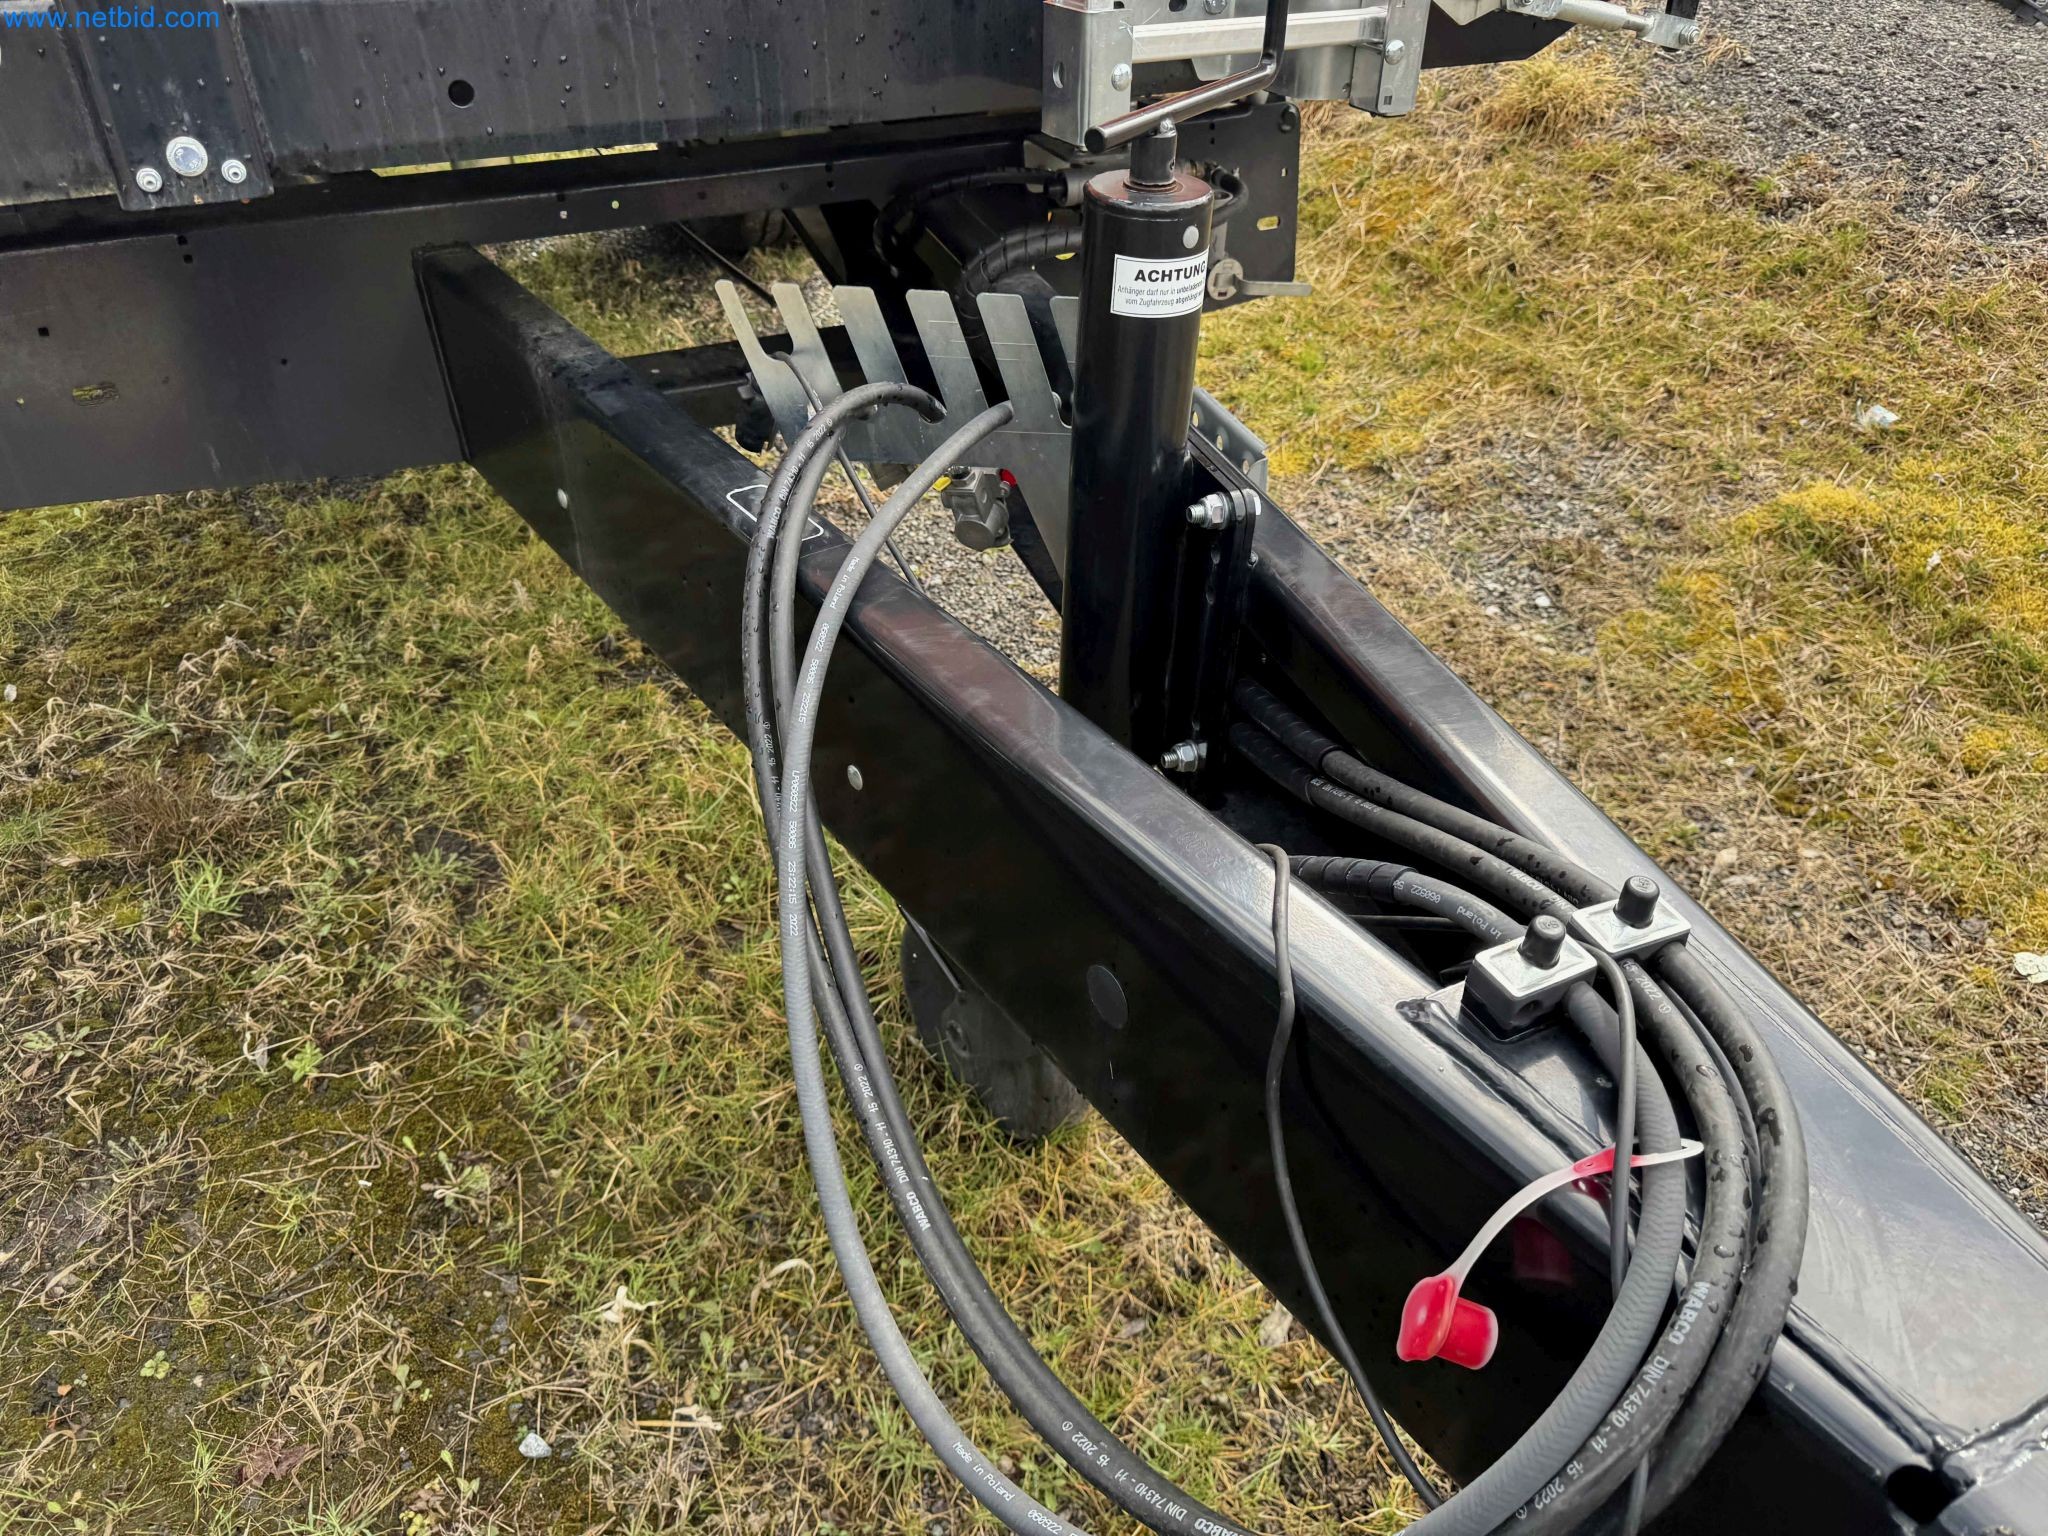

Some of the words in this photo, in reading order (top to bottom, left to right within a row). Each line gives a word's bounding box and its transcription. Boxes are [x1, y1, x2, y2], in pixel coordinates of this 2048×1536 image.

[1134, 261, 1206, 282] ACHTUNG
[1117, 285, 1145, 297] Anhänger
[1146, 288, 1159, 296] darf
[1160, 288, 1169, 296] nur
[1139, 297, 1174, 308] Zugfahrzeug
[841, 574, 850, 583] in
[829, 583, 847, 610] Poland
[789, 913, 799, 937] 2022
[1456, 905, 1489, 930] Poland
[1635, 975, 1663, 1000] 2022
[857, 1074, 874, 1098] 2022
[867, 1102, 879, 1113] 15
[882, 1138, 901, 1167] 74310
[893, 1166, 910, 1184] DIN
[905, 1191, 931, 1231] WABCO
[1669, 1281, 1711, 1345] WABCO
[1643, 1356, 1670, 1385] DIN
[1612, 1384, 1651, 1428] 74310
[1071, 1431, 1098, 1456] 2022
[952, 1441, 973, 1464] Made
[973, 1463, 984, 1476] in
[983, 1473, 1015, 1502] Poland
[1096, 1454, 1111, 1467] 15
[1566, 1460, 1584, 1480] 15
[1134, 1482, 1167, 1509] 74310
[1534, 1476, 1565, 1510] 2022
[1163, 1501, 1188, 1521] DIN
